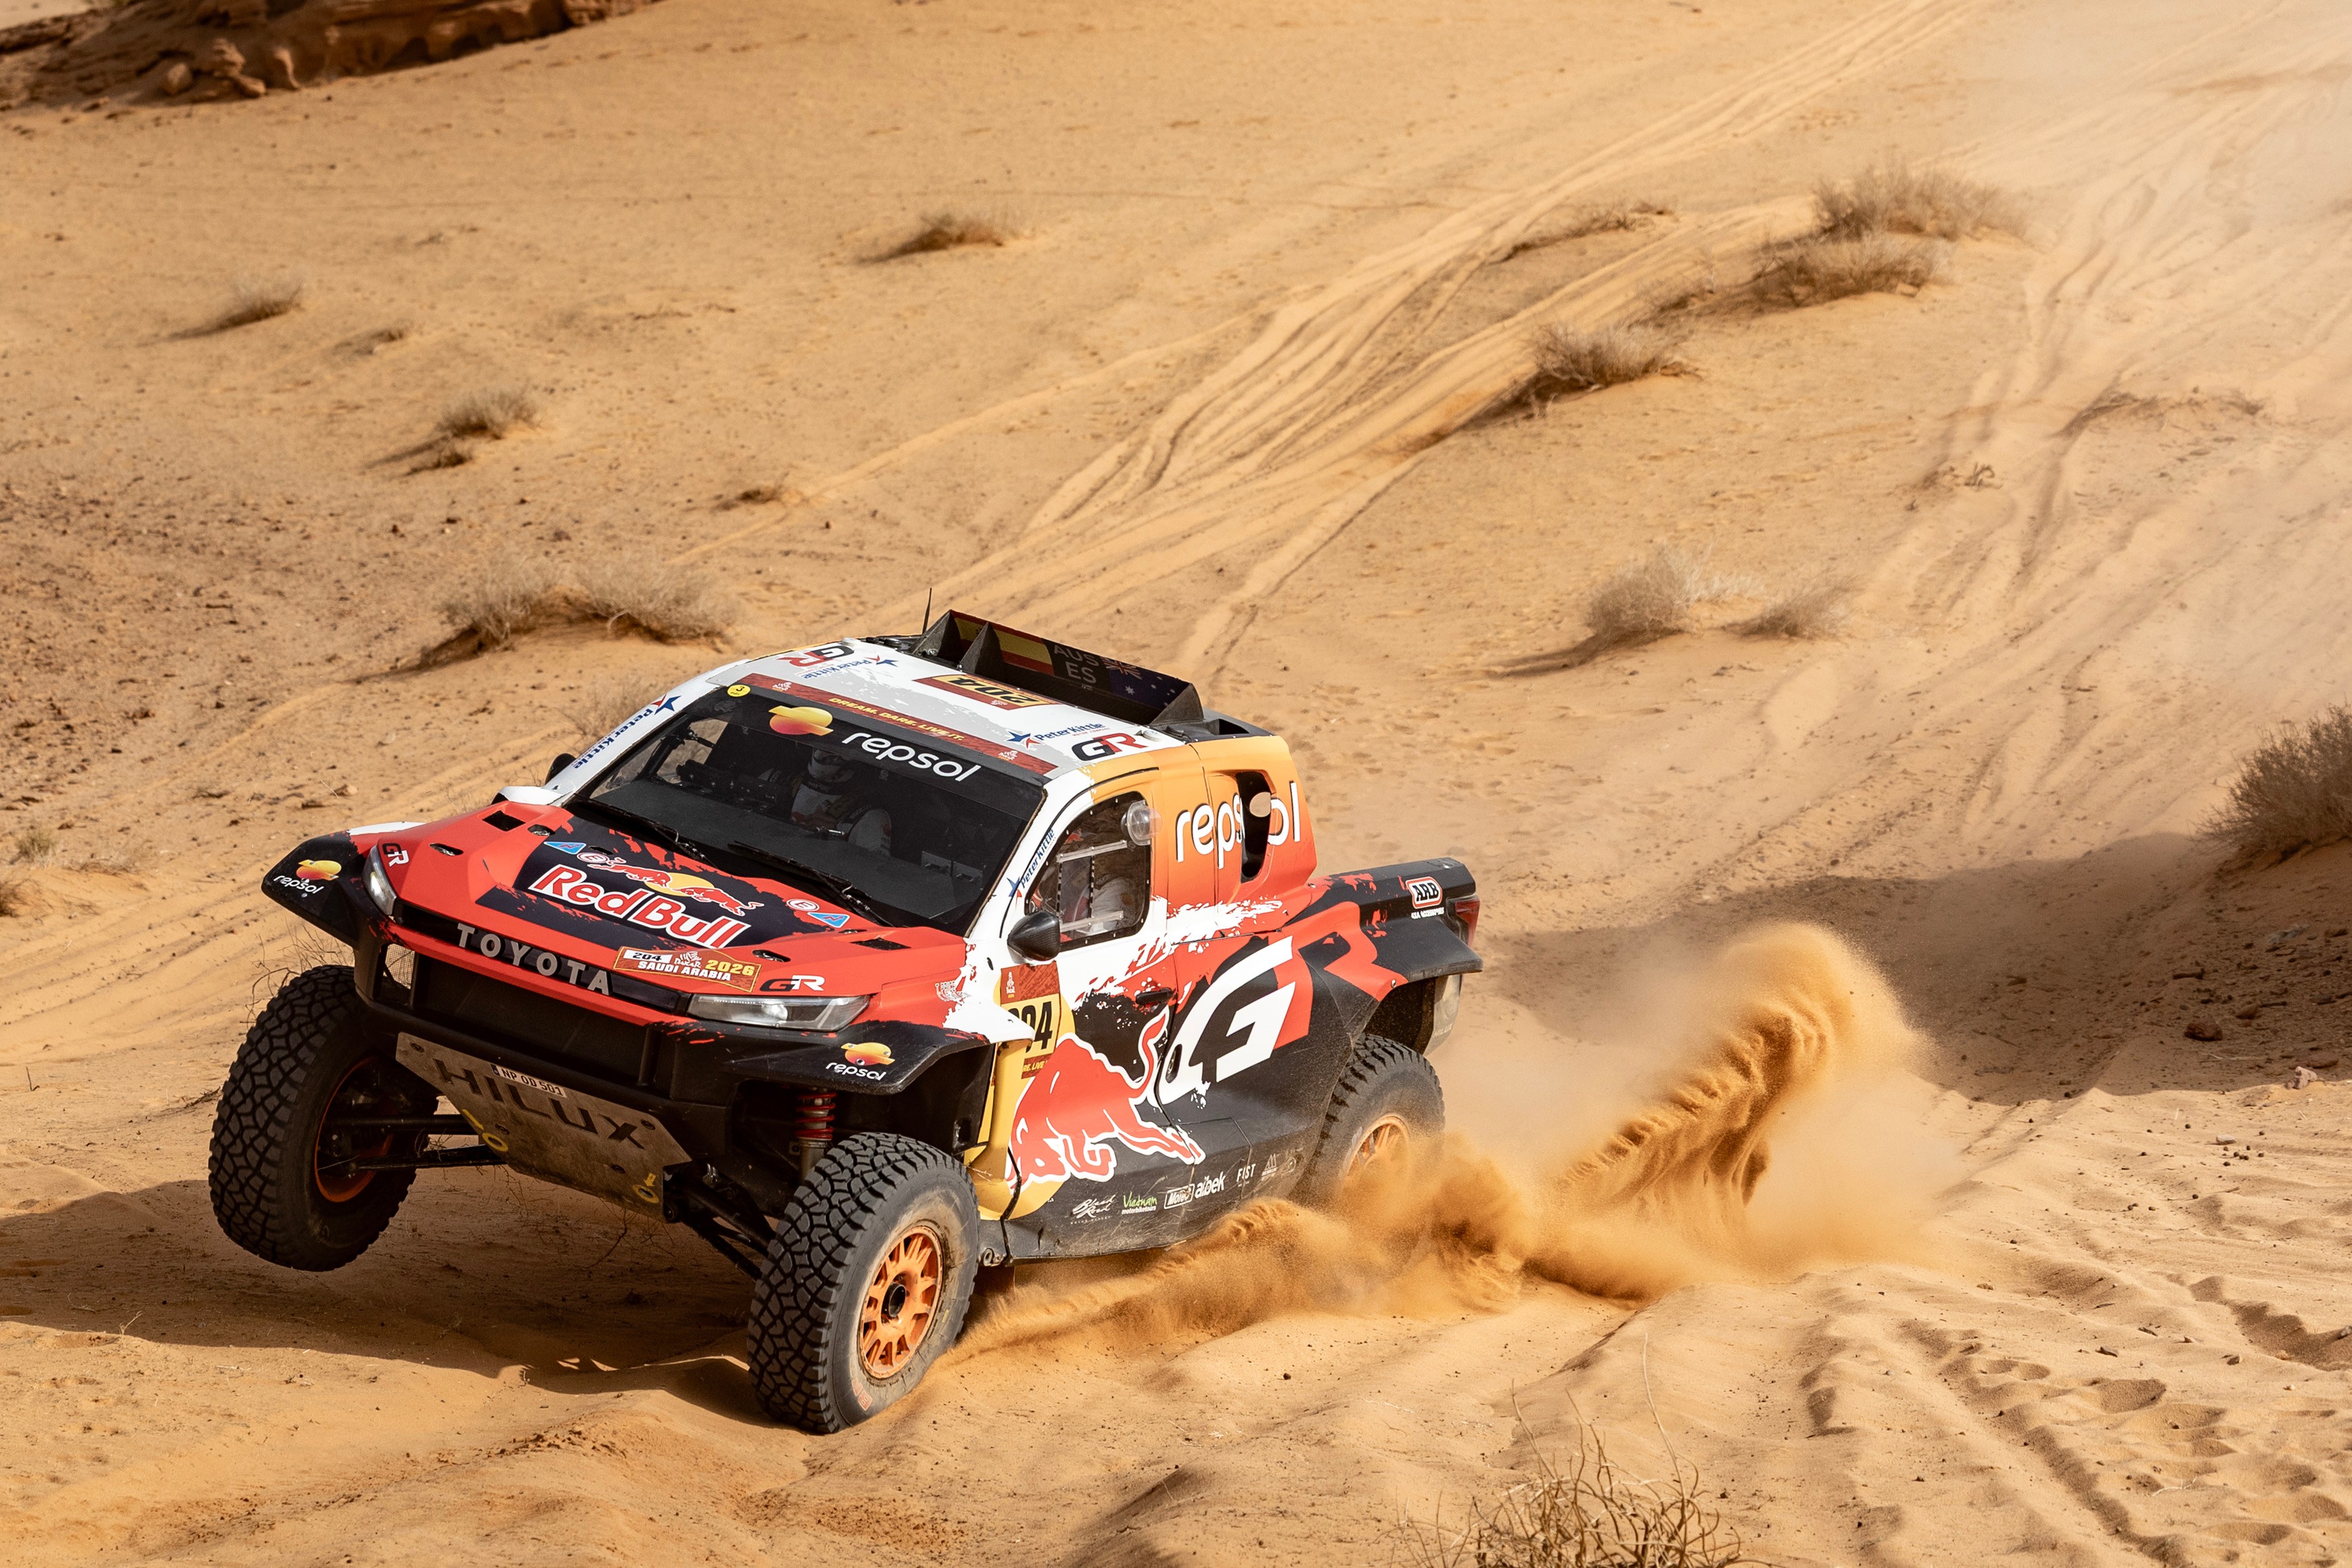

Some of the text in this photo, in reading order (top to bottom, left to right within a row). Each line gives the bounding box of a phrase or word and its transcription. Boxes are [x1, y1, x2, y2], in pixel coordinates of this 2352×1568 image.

[1054, 644, 1099, 666] AUS
[1065, 661, 1097, 684] ES
[948, 677, 1040, 703] 204
[614, 708, 654, 738] Peter
[918, 724, 948, 736] LIVE
[573, 737, 615, 769] Kittle
[841, 732, 982, 782] repsol
[1071, 732, 1148, 761] GR
[382, 842, 409, 867] GR
[273, 875, 324, 894] repsol
[1412, 882, 1439, 902] ARB
[530, 865, 751, 949] Red Bull
[458, 922, 610, 996] TOYOTA
[632, 952, 663, 961] 204
[705, 959, 755, 976] 2026
[638, 961, 732, 982] SAUDI ARABIA
[759, 975, 825, 992] GR
[1008, 1001, 1053, 1053] 04
[501, 1068, 517, 1081] NP
[538, 1081, 564, 1096] 501
[825, 1062, 887, 1081] repsol
[433, 1058, 646, 1150] HILUX
[1236, 1164, 1257, 1182] FIST
